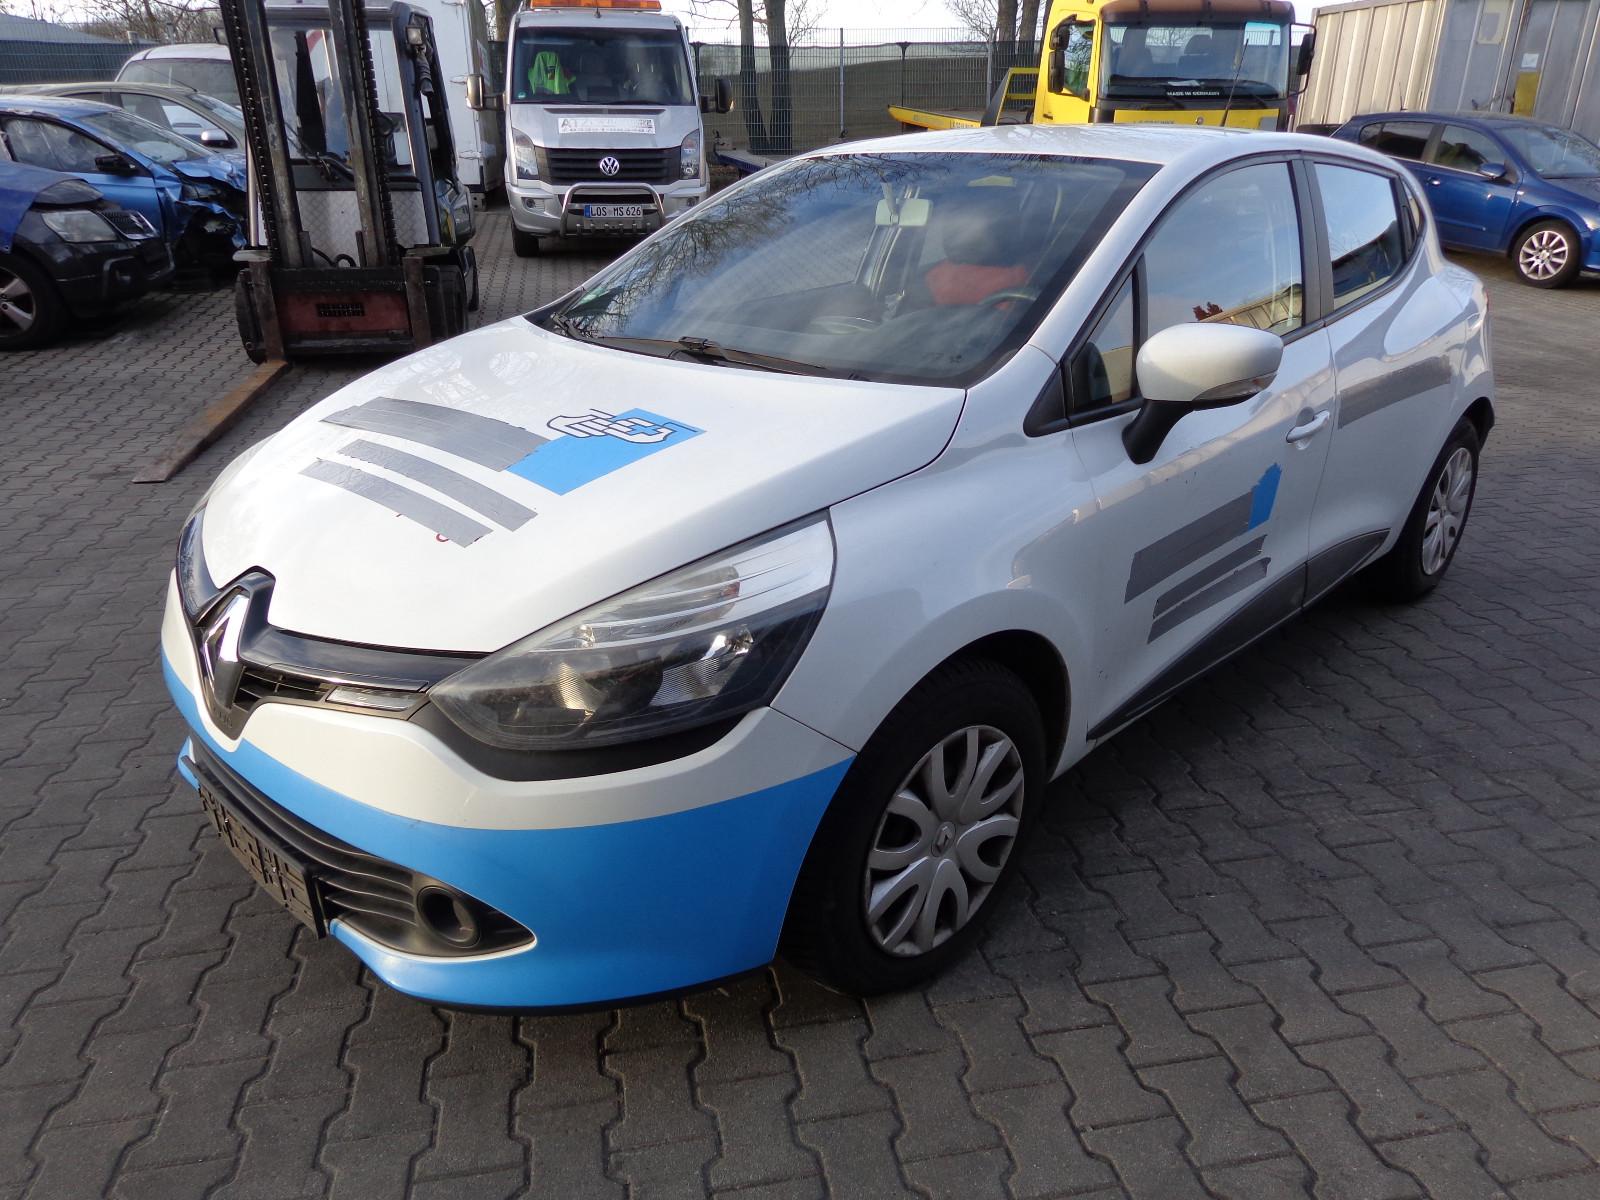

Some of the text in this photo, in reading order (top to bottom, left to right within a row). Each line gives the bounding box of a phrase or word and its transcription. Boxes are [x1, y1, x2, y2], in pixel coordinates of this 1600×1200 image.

[590, 206, 641, 217] LOS MS 626
